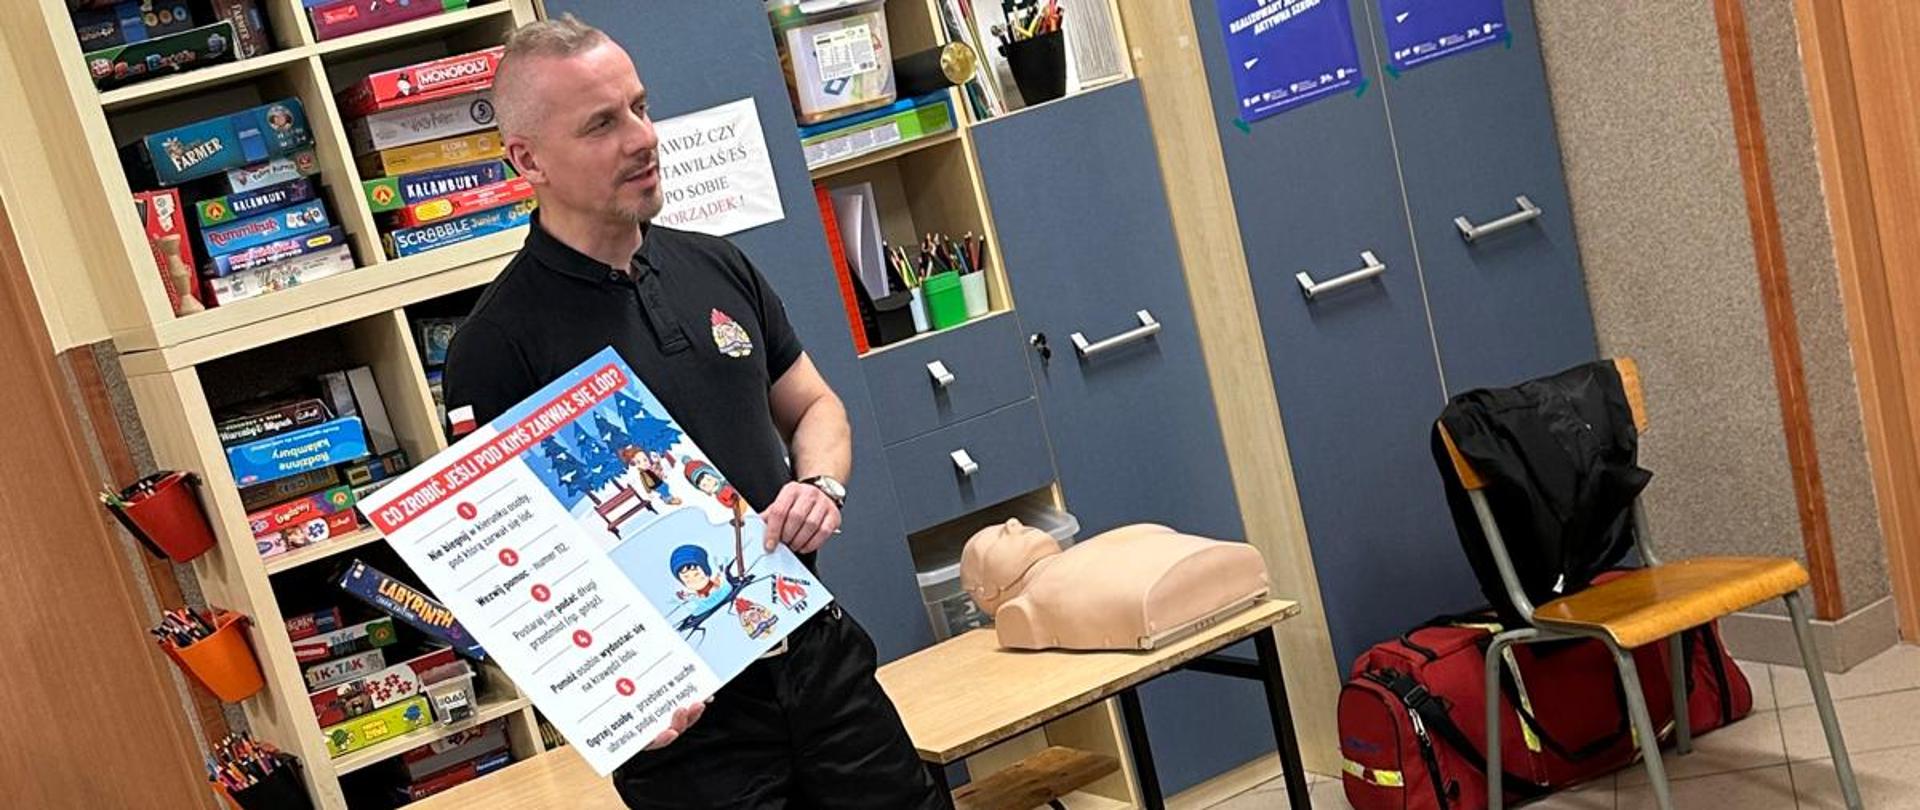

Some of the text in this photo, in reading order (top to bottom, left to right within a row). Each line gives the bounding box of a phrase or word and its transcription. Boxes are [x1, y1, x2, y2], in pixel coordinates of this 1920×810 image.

[421, 60, 487, 85] MONOPOLY
[708, 122, 737, 144] CZY
[170, 137, 224, 172] FARMER
[233, 191, 287, 212] KALAMBURY
[407, 174, 481, 199] KALAMBURY
[665, 176, 730, 204] PO SOBIE
[208, 219, 279, 246] Rummikub
[399, 220, 471, 248] SCRABBLE
[381, 506, 404, 526] CO
[399, 479, 446, 515] ZROBIĆ
[444, 460, 479, 489] JEŚLI
[473, 445, 503, 469] POD
[498, 425, 531, 453] KIMŚ
[525, 400, 576, 436] ZARWAŁ
[571, 386, 596, 407] SIĘ
[589, 368, 621, 395] LÓD?
[427, 549, 444, 562] Nie
[440, 530, 471, 553] biegnij
[474, 508, 508, 531] kierunku
[448, 553, 465, 570] pod
[461, 542, 486, 559] którą
[482, 525, 509, 546] zarwał
[507, 518, 521, 530] się
[475, 584, 506, 607] Wezwij
[503, 569, 530, 591] pomoc
[532, 551, 556, 570] numer
[379, 578, 455, 628] LABYRINTH
[512, 581, 597, 640] Postaraj się podać długi
[529, 621, 566, 650] przedmiot
[549, 623, 646, 694] Pomóż osobie wydostać się
[581, 682, 593, 692] na
[590, 660, 621, 684] krawędź
[586, 726, 613, 748] Ogrzej
[610, 711, 634, 731] osobę
[636, 684, 669, 712] przebierz
[674, 664, 695, 683] suche
[634, 714, 658, 733] podaj
[654, 699, 677, 717] ciepły
